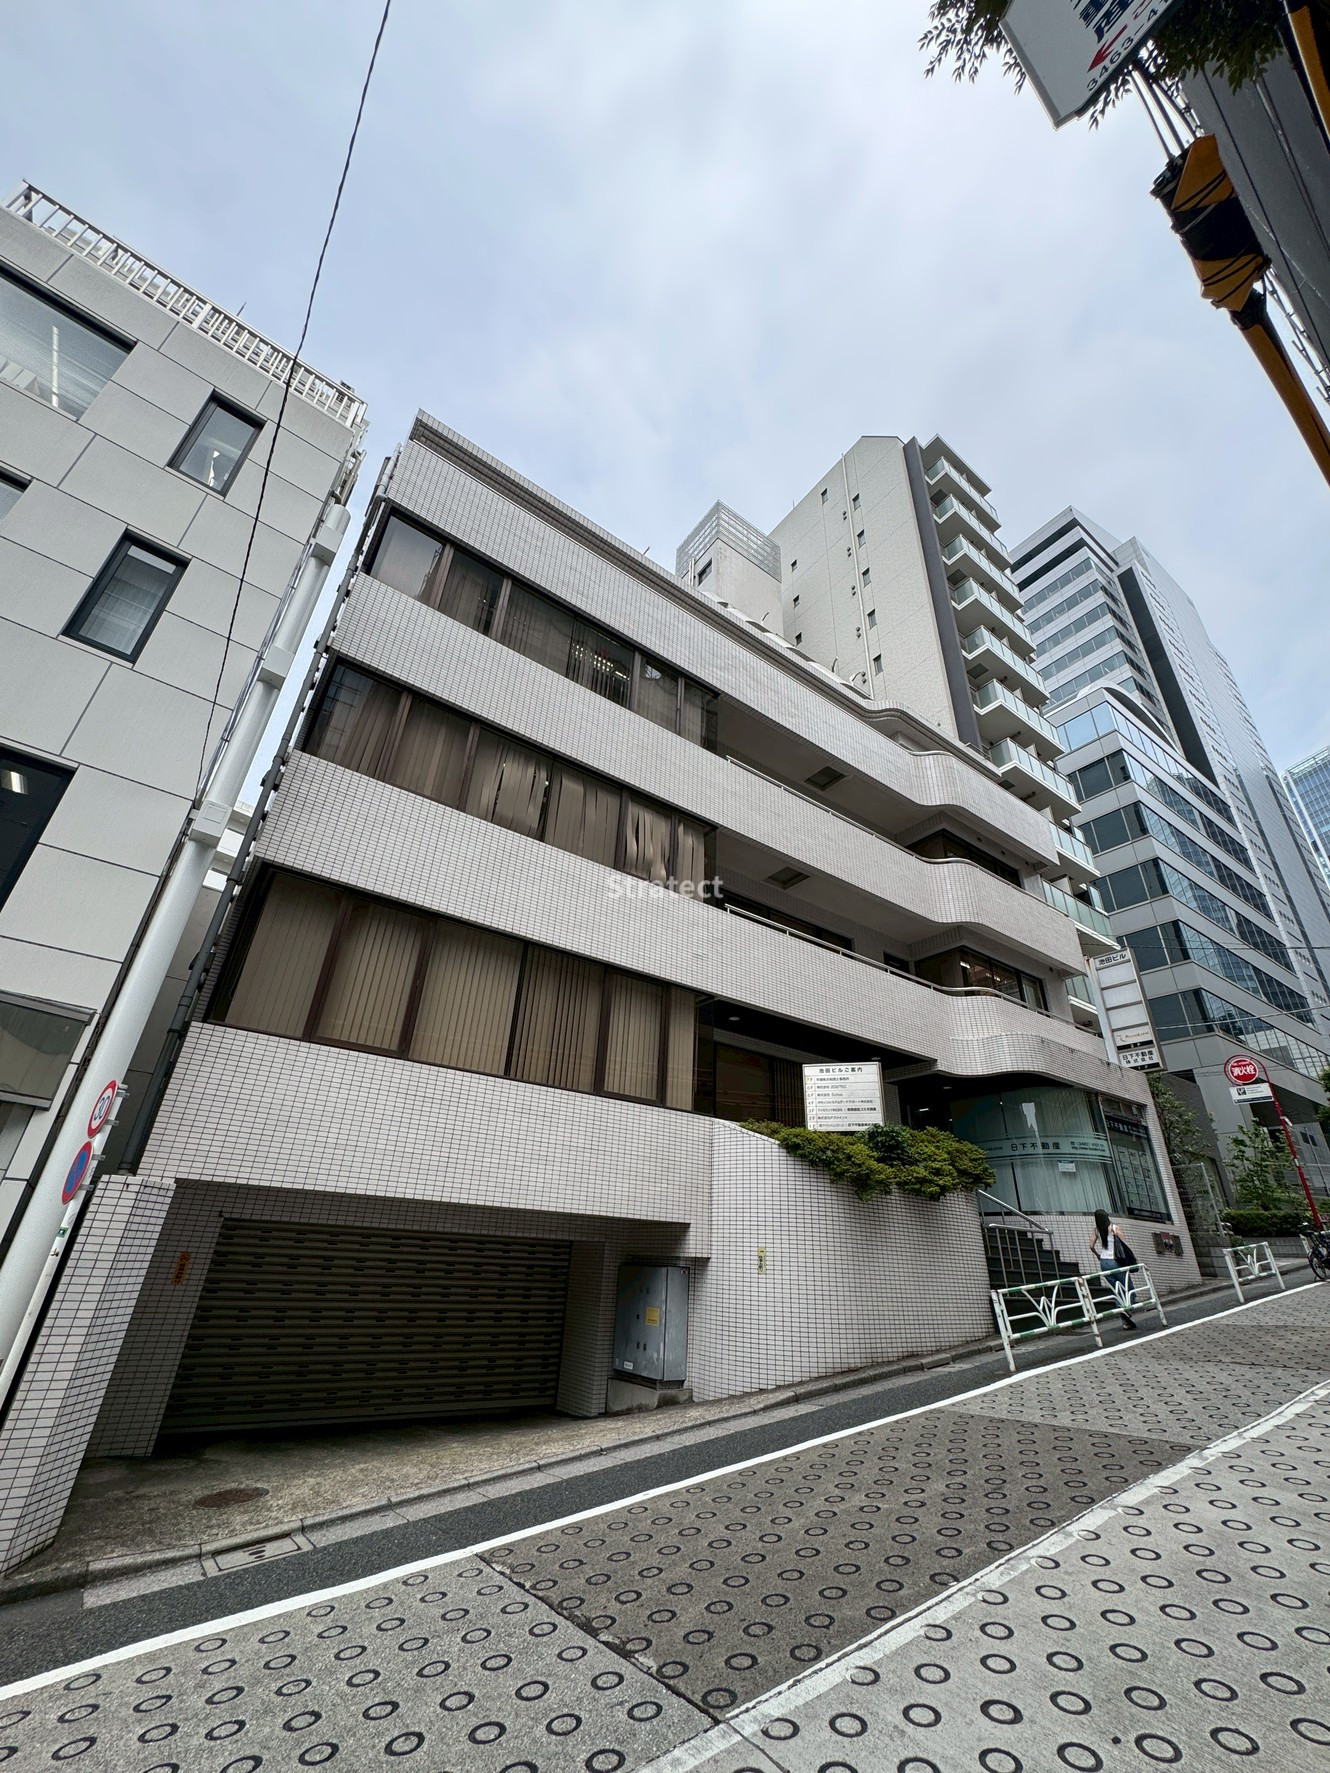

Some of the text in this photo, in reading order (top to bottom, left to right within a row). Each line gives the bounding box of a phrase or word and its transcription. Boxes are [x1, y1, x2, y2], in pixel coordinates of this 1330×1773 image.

[1098, 952, 1126, 965] 池田ビル
[1122, 1050, 1154, 1060] 日下不動産
[1231, 1065, 1256, 1076] 消火栓
[93, 1095, 111, 1121] 30
[1011, 1142, 1061, 1151] 日下不動産
